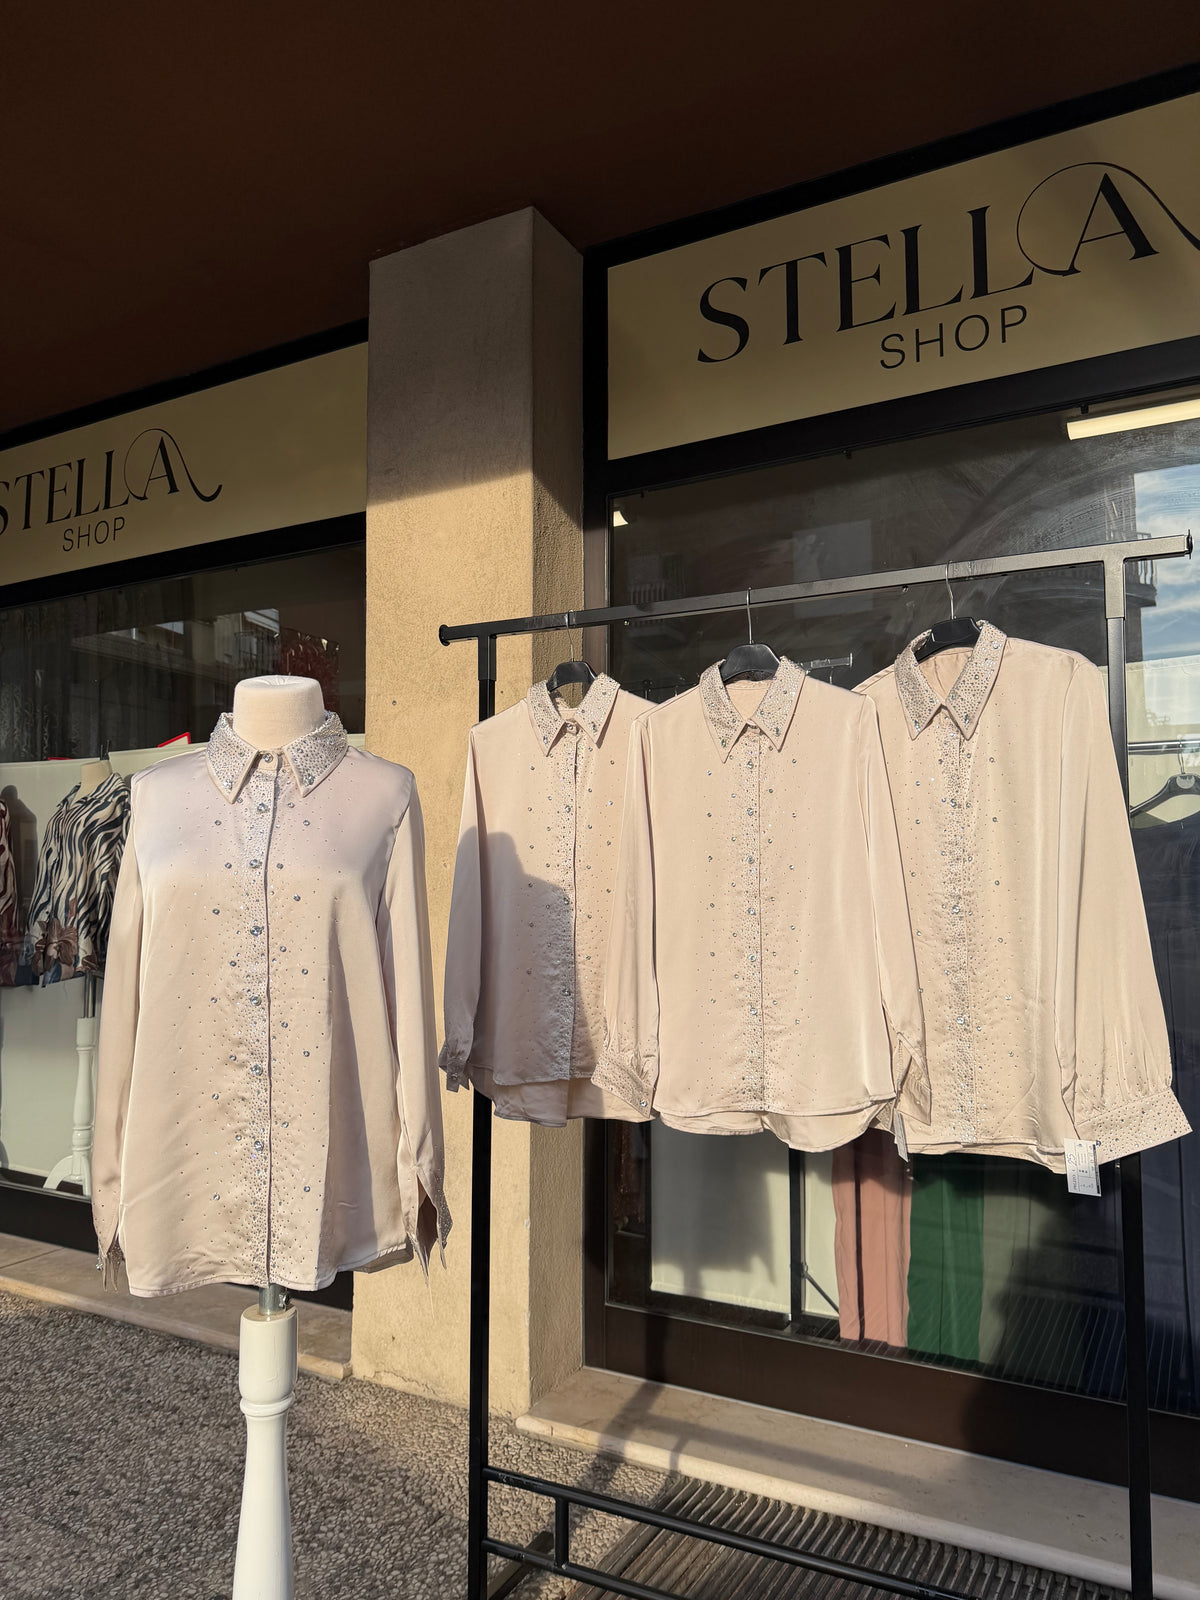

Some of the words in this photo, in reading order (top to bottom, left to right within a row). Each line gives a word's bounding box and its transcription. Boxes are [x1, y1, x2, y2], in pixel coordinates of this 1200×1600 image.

[697, 161, 1200, 363] STELLA
[879, 304, 1028, 370] SHOP
[62, 516, 126, 552] SHOP
